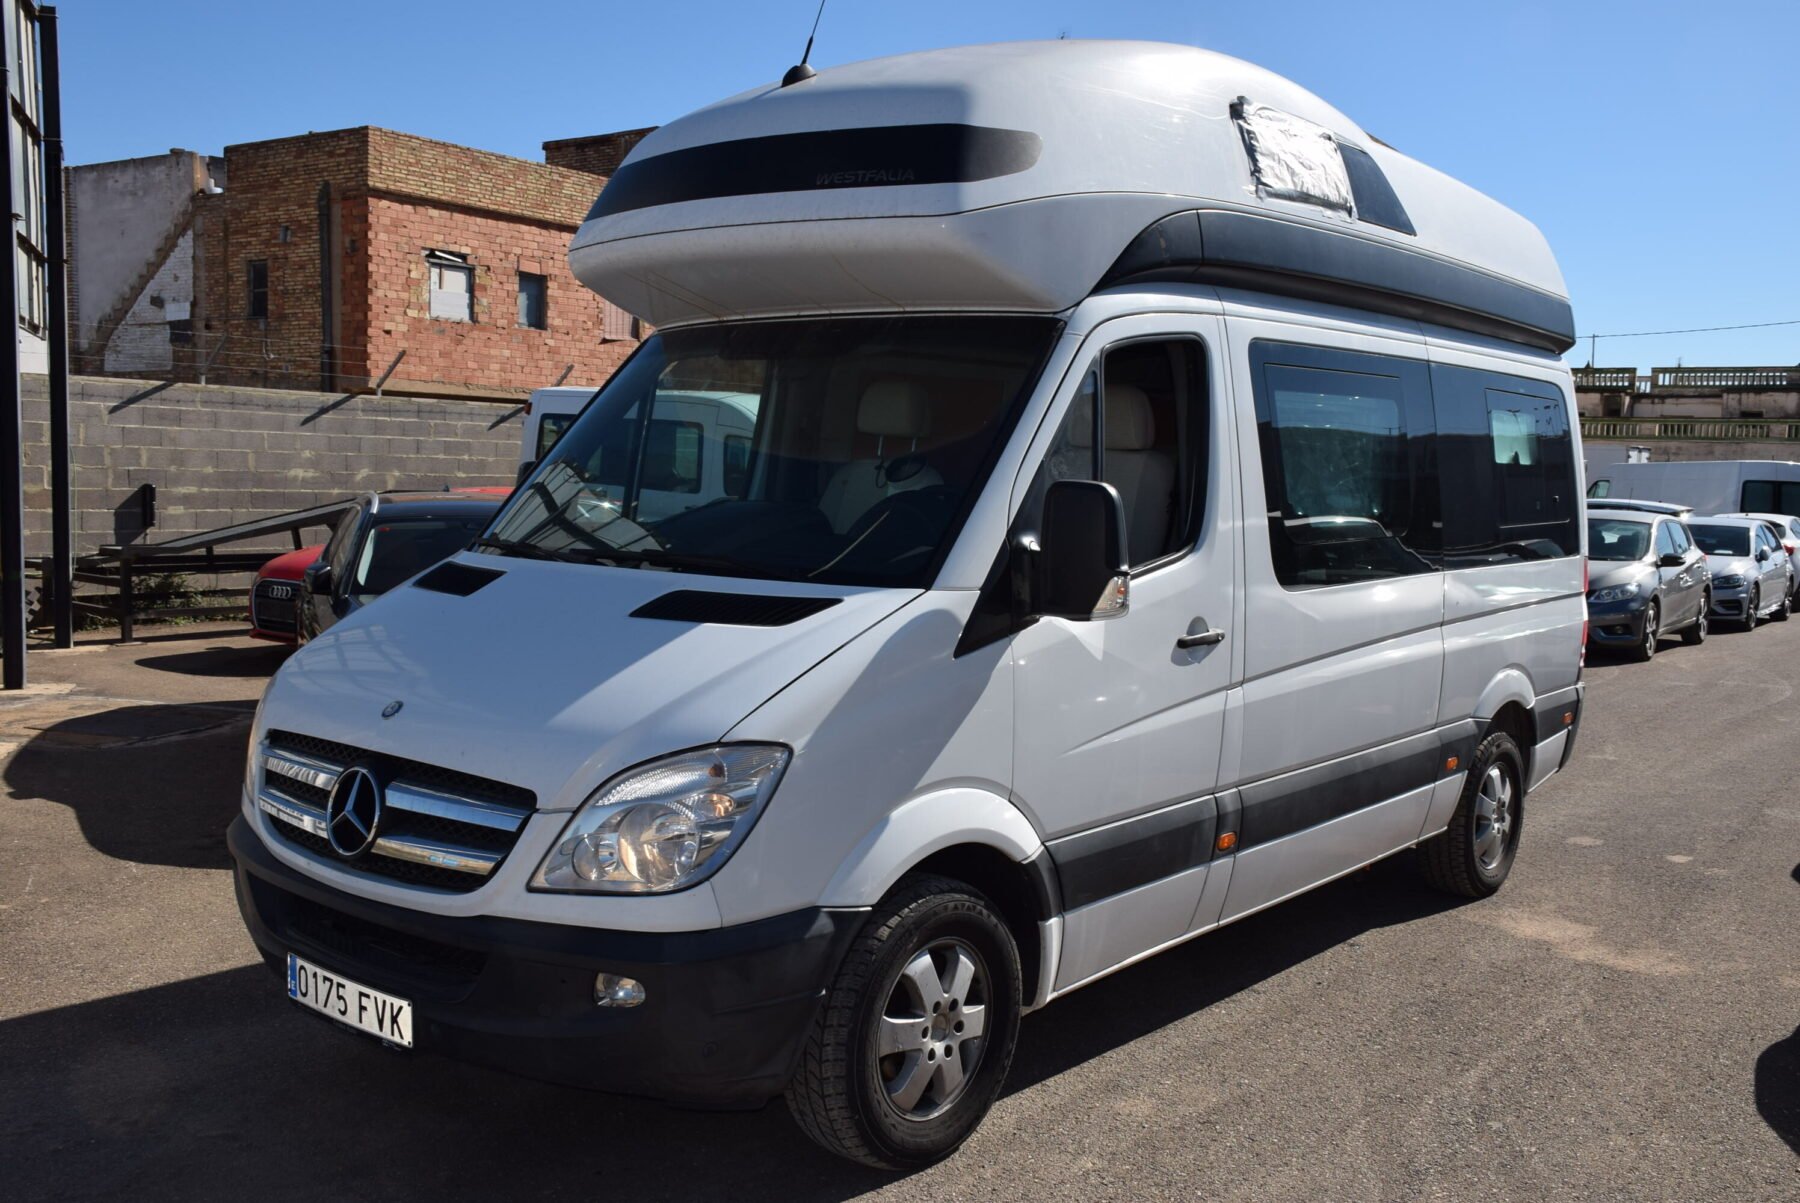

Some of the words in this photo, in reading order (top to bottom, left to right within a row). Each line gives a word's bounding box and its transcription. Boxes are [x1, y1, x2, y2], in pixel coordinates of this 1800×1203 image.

[815, 168, 916, 185] WESTFALIA
[298, 965, 348, 1016] 0175
[358, 990, 404, 1040] FVK
